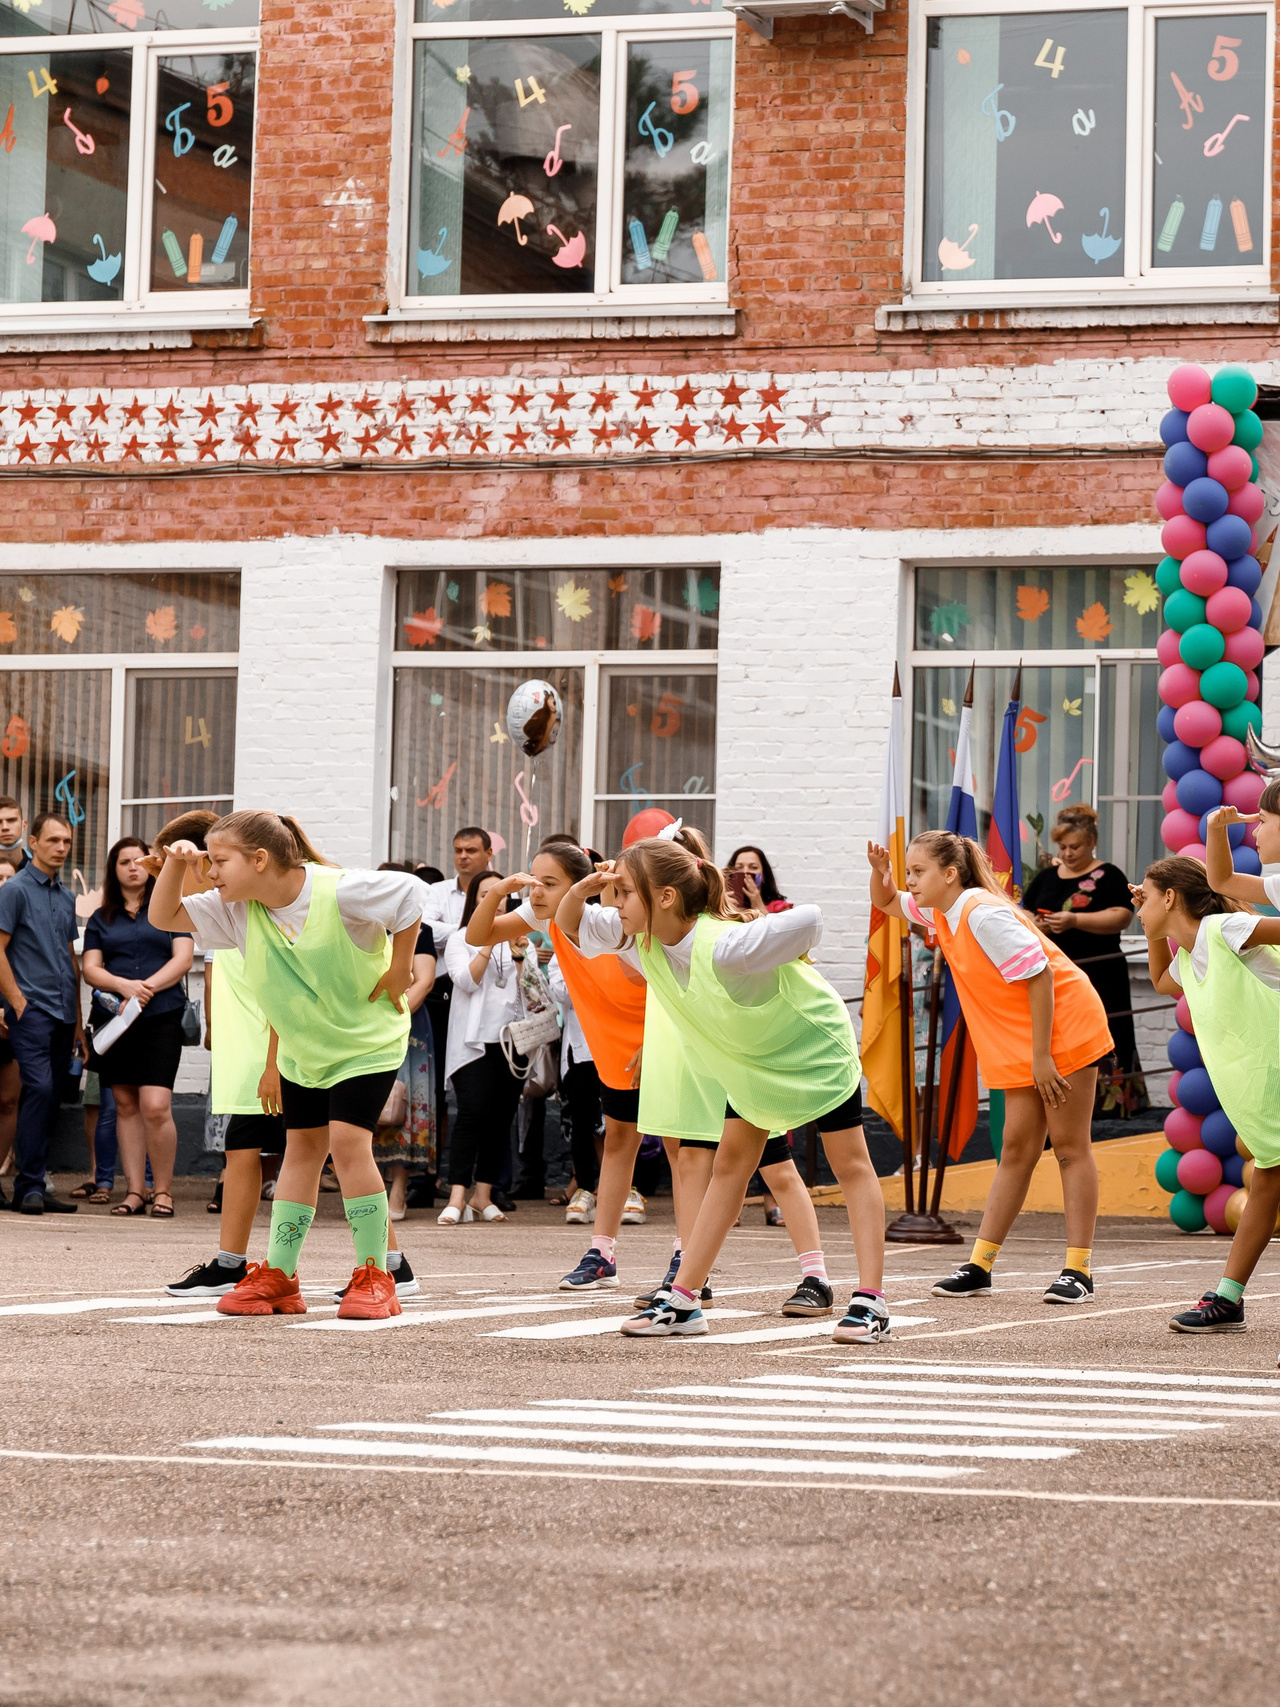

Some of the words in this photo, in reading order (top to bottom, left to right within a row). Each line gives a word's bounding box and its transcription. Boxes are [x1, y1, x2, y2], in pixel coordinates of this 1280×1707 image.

[1034, 38, 1067, 79] 4
[1207, 35, 1243, 82] 5
[27, 67, 58, 98] 4
[206, 81, 234, 127] 5
[514, 75, 547, 108] 4
[670, 69, 699, 115] 5
[184, 715, 212, 748] 4
[651, 692, 684, 738] 5
[1013, 705, 1048, 753] 5
